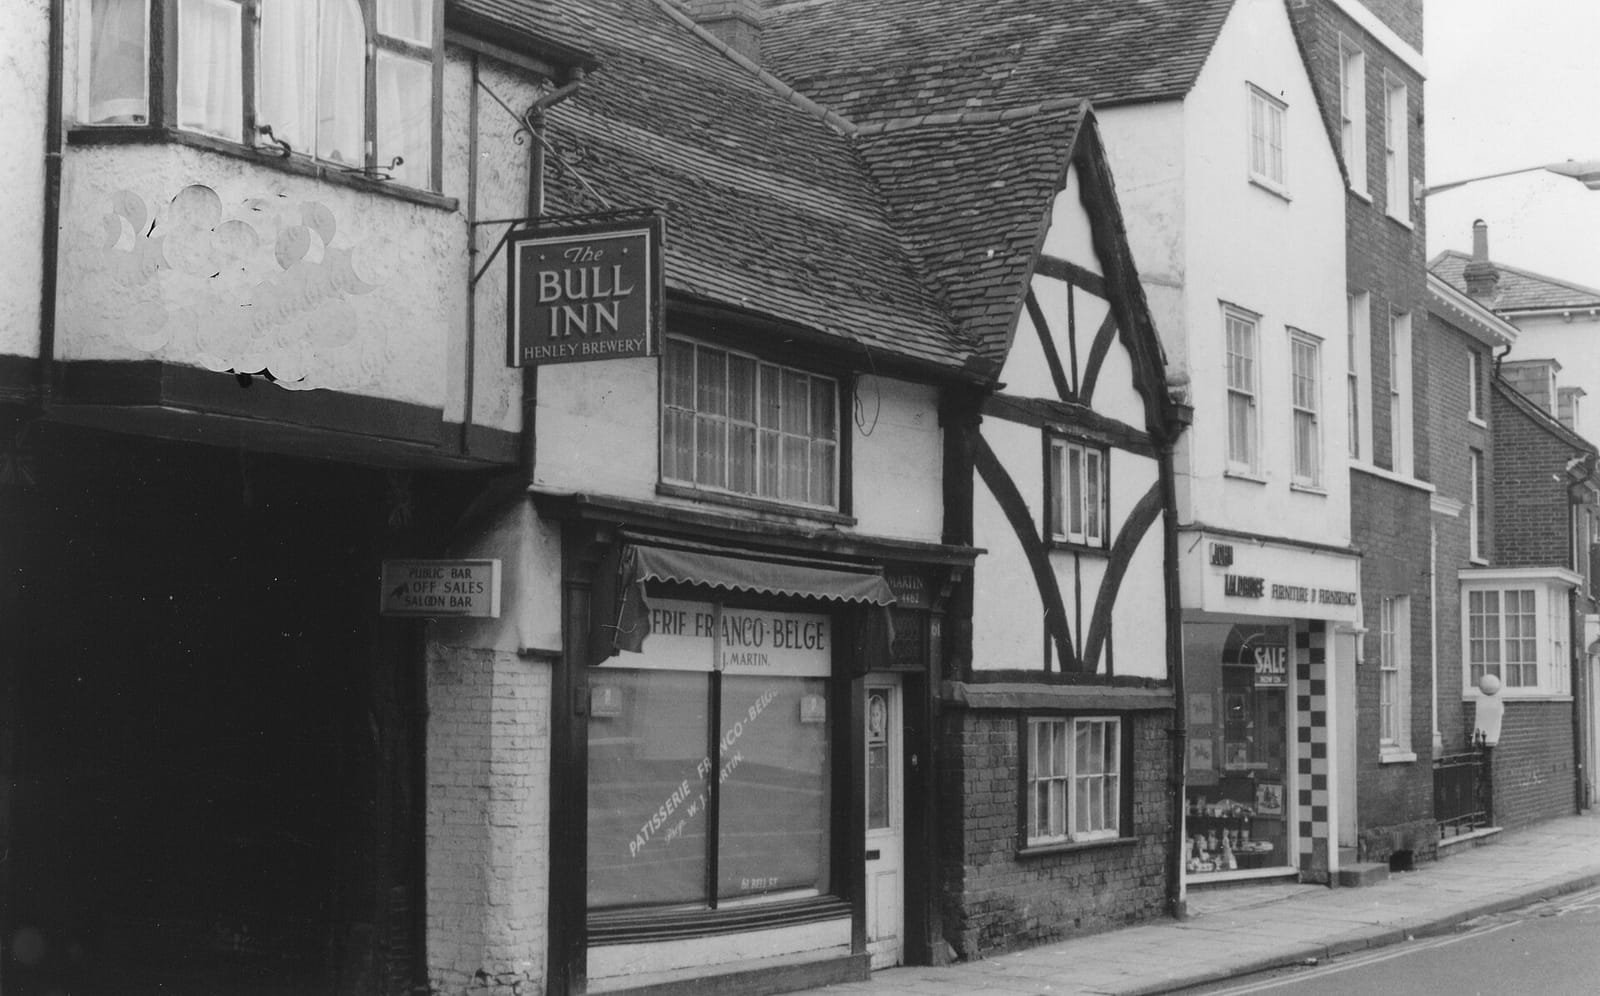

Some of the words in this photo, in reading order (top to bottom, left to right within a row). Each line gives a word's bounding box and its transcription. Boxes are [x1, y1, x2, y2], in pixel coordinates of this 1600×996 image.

[564, 246, 604, 262] The
[538, 264, 635, 302] BULL
[550, 301, 620, 336] INN
[524, 343, 578, 359] HENLEY
[582, 338, 644, 355] BREWERY
[409, 567, 444, 579] PUBLIC
[451, 568, 472, 579] BAR
[413, 582, 436, 593] OFF
[444, 581, 484, 594] SALES
[405, 595, 445, 607] SALOON
[450, 596, 472, 607] BAR
[1254, 647, 1285, 673] SALE
[628, 779, 691, 858] PATISSERIE
